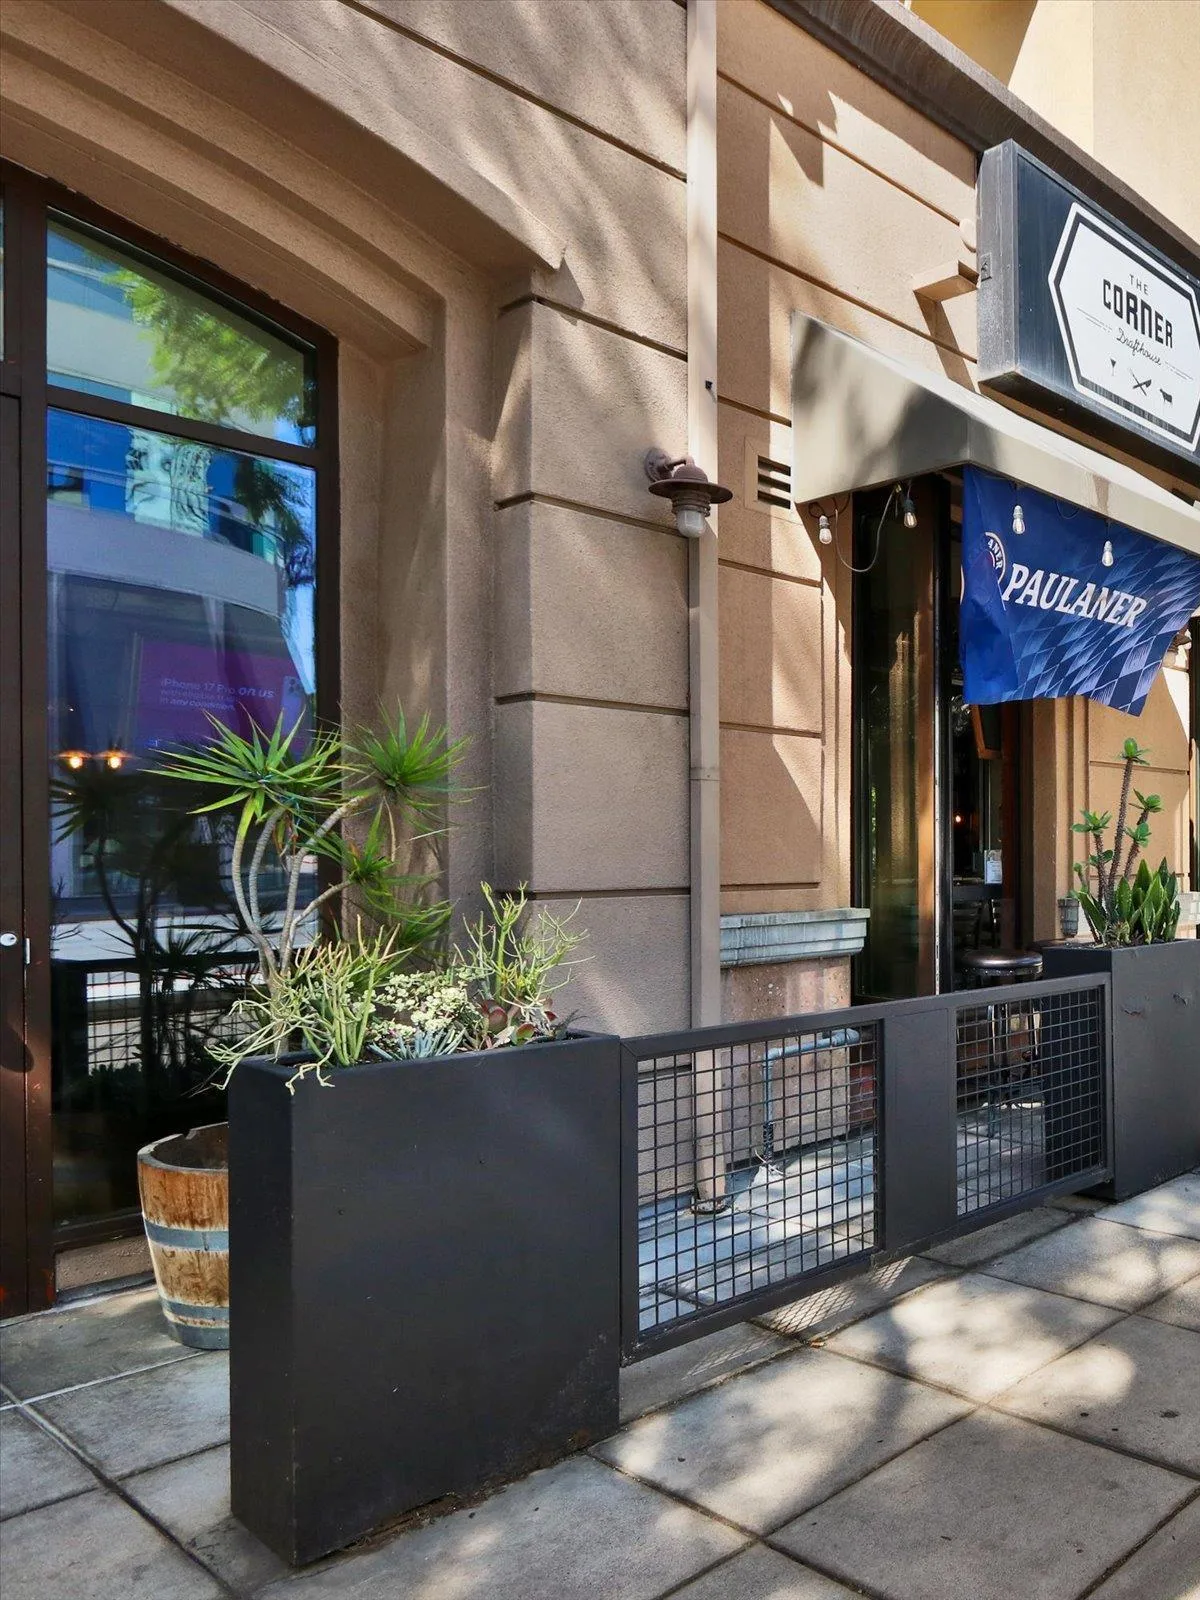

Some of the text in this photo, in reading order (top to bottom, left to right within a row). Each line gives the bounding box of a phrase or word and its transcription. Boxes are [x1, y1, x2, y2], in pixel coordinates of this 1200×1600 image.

[1130, 273, 1149, 296] THE
[1103, 279, 1173, 349] CORNER
[1116, 327, 1162, 366] Drafthouse
[1001, 563, 1148, 628] PAULANER
[239, 687, 256, 696] on
[259, 688, 275, 698] us
